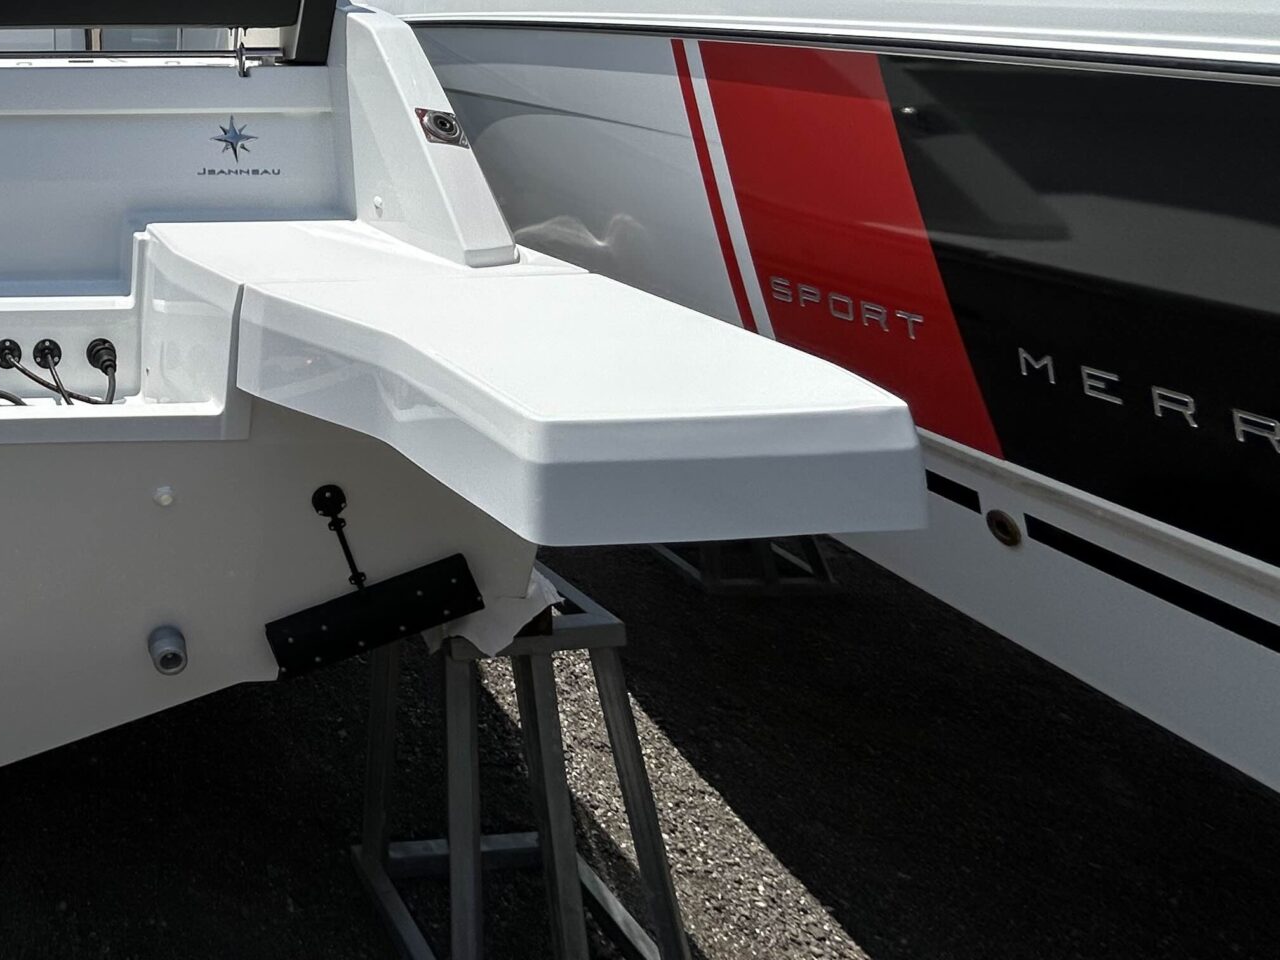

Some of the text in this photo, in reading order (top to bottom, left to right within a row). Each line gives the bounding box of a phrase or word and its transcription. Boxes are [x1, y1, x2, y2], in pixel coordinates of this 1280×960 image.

[196, 167, 281, 176] JEANNEAU
[771, 276, 925, 340] SPORT
[1017, 346, 1280, 454] MERR
